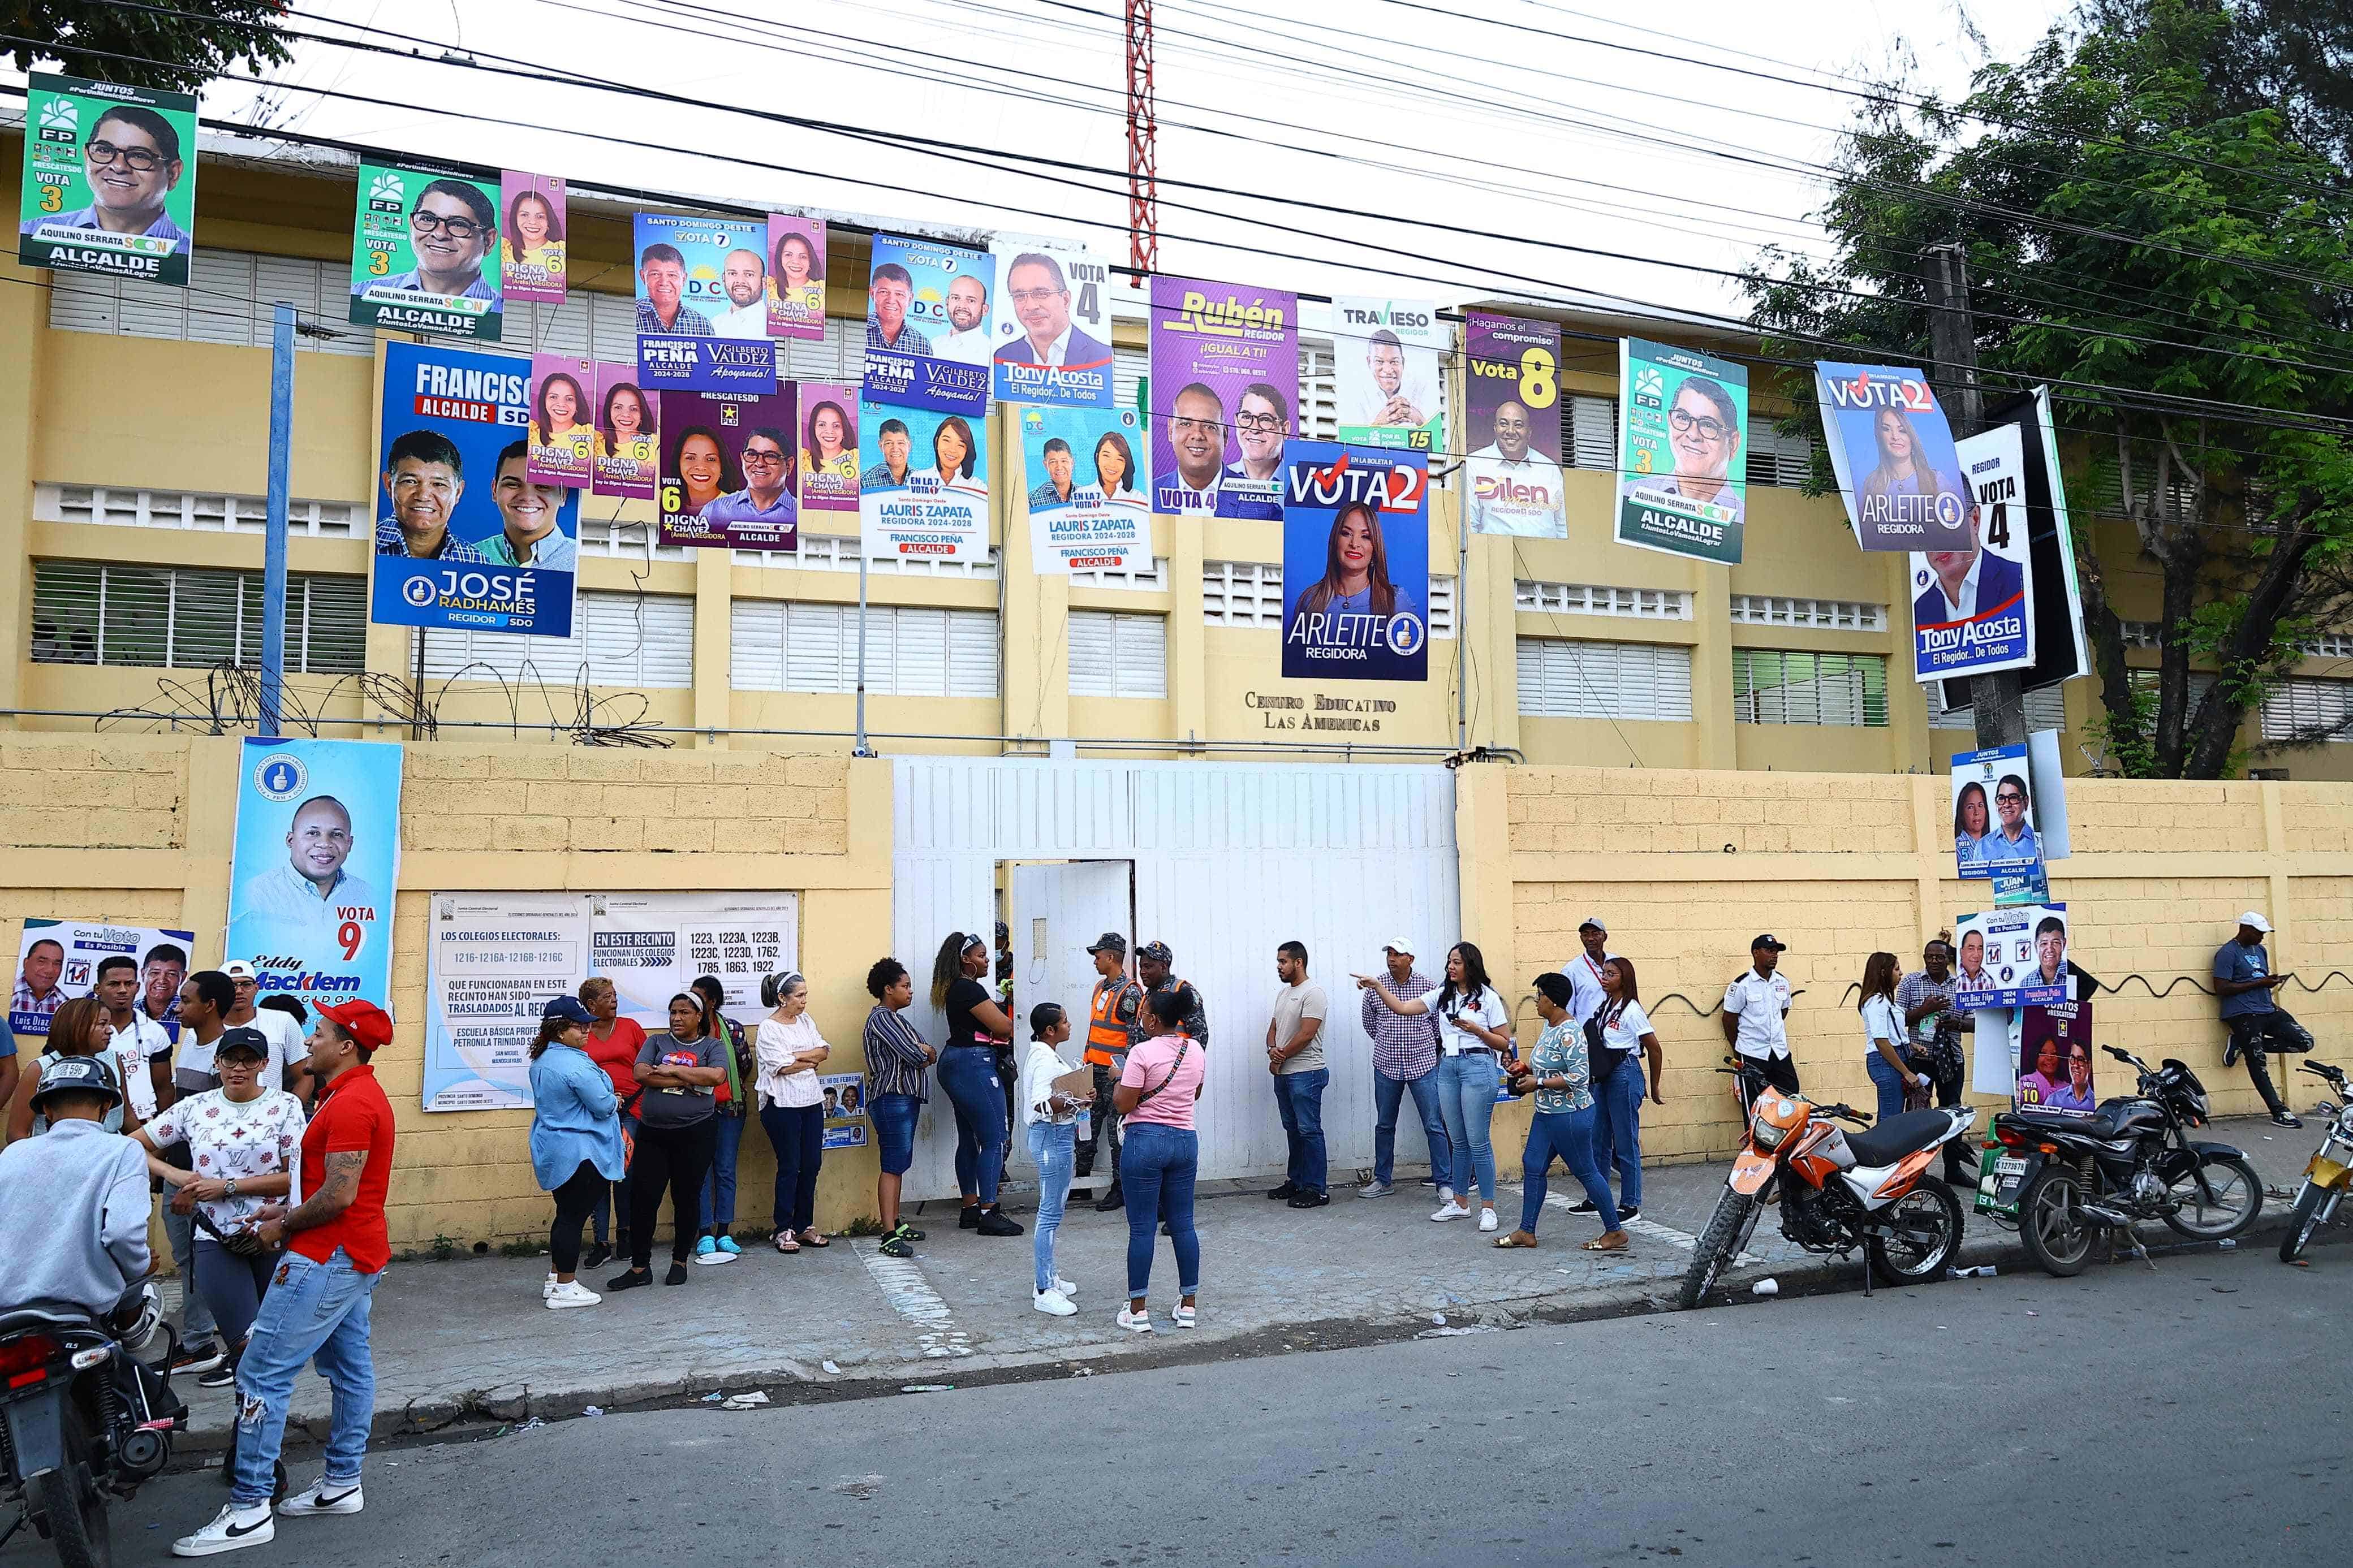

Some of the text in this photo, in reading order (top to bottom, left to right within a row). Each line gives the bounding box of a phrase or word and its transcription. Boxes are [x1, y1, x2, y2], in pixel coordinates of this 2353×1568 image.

[90, 83, 135, 95] JUNTOS
[42, 131, 74, 141] FP
[36, 171, 71, 186] VOTA
[40, 185, 63, 212] 3
[372, 201, 400, 211] FP
[647, 218, 755, 232] SANTO DOMINGO OESTE
[366, 239, 397, 252] VOTA
[49, 247, 160, 271] ALCALDE
[369, 250, 389, 275] 3
[546, 255, 562, 274] 6
[1069, 262, 1105, 283] VOTA
[806, 293, 820, 310] 6
[1077, 283, 1100, 324] 4
[377, 306, 476, 329] ALCALDE
[1180, 291, 1285, 334] Rubén
[1343, 301, 1429, 327] TRAVIESO
[1468, 318, 1525, 332] ¡Hagamos el
[1245, 329, 1285, 342] REGIDOR
[1492, 331, 1554, 345] compromiso!
[643, 340, 697, 349] FRANCISCO
[1200, 343, 1266, 358] ¡IGUAL A TI!
[865, 353, 915, 367] FRANCISCO
[1670, 353, 1703, 368] JUNTOS
[1003, 362, 1103, 386] Tony Acosta
[1471, 360, 1517, 379] Vota
[869, 375, 908, 386] ALCALDE
[1519, 347, 1557, 409] 8
[872, 384, 906, 393] 2024-2028
[1636, 394, 1660, 407] FP
[1410, 432, 1430, 447] 15
[1632, 435, 1658, 451] VOTA
[573, 440, 589, 459] 6
[633, 442, 649, 460] 6
[1635, 448, 1652, 475] 3
[1972, 457, 2000, 474] REGIDOR
[839, 461, 856, 479] 6
[1475, 476, 1549, 504] Dilen
[1979, 477, 2015, 505] VOTA
[662, 486, 681, 512] 6
[1162, 490, 1215, 509] VOTA 4
[1238, 494, 1278, 503] ALCALDE
[881, 504, 972, 518] LAURIS ZAPATA
[1862, 494, 1935, 522] ARLETTE
[1050, 519, 1135, 532] LAURIS ZAPATA
[1640, 509, 1723, 540] ALCALDE
[1878, 524, 1925, 534] REGIDORA
[1988, 502, 2010, 550] 4
[739, 533, 780, 542] ALCALDE
[907, 545, 949, 554] ALCALDE
[1077, 558, 1115, 567] ALCALDE
[439, 569, 535, 603] JOSÉ
[448, 613, 533, 627] REGIDOR SDO
[1287, 612, 1386, 647] ARLETTE
[1920, 615, 2022, 654] Tony Acosta
[1306, 647, 1367, 659] REGIDORA
[1962, 849, 1968, 860] 5
[2000, 877, 2024, 888] JUAN
[337, 907, 374, 921] VOTA
[2005, 911, 2029, 923] Voto
[74, 930, 91, 939] Con
[103, 928, 140, 944] Voto
[338, 922, 361, 961] 9
[441, 932, 561, 940] LOS COLEGIOS ELECTORALES:
[596, 934, 673, 946] EN ESTE RECINTO
[691, 932, 781, 944] 1223, 1223A, 1223B,
[594, 949, 631, 957] FUNCIONAN
[645, 948, 675, 957] COLEGIOS
[251, 955, 303, 971] Eddy
[594, 958, 638, 967] ELECTORALES
[449, 979, 567, 990] QUE FUNCIONABAN EN ESTE
[448, 991, 531, 1001] RECINTO HAN SIDO
[448, 1003, 524, 1017] TRASLADADOS AL
[454, 1037, 525, 1047] PETRONILA TRINIDAD
[69, 1065, 83, 1074] 596
[2022, 1088, 2039, 1103] 10
